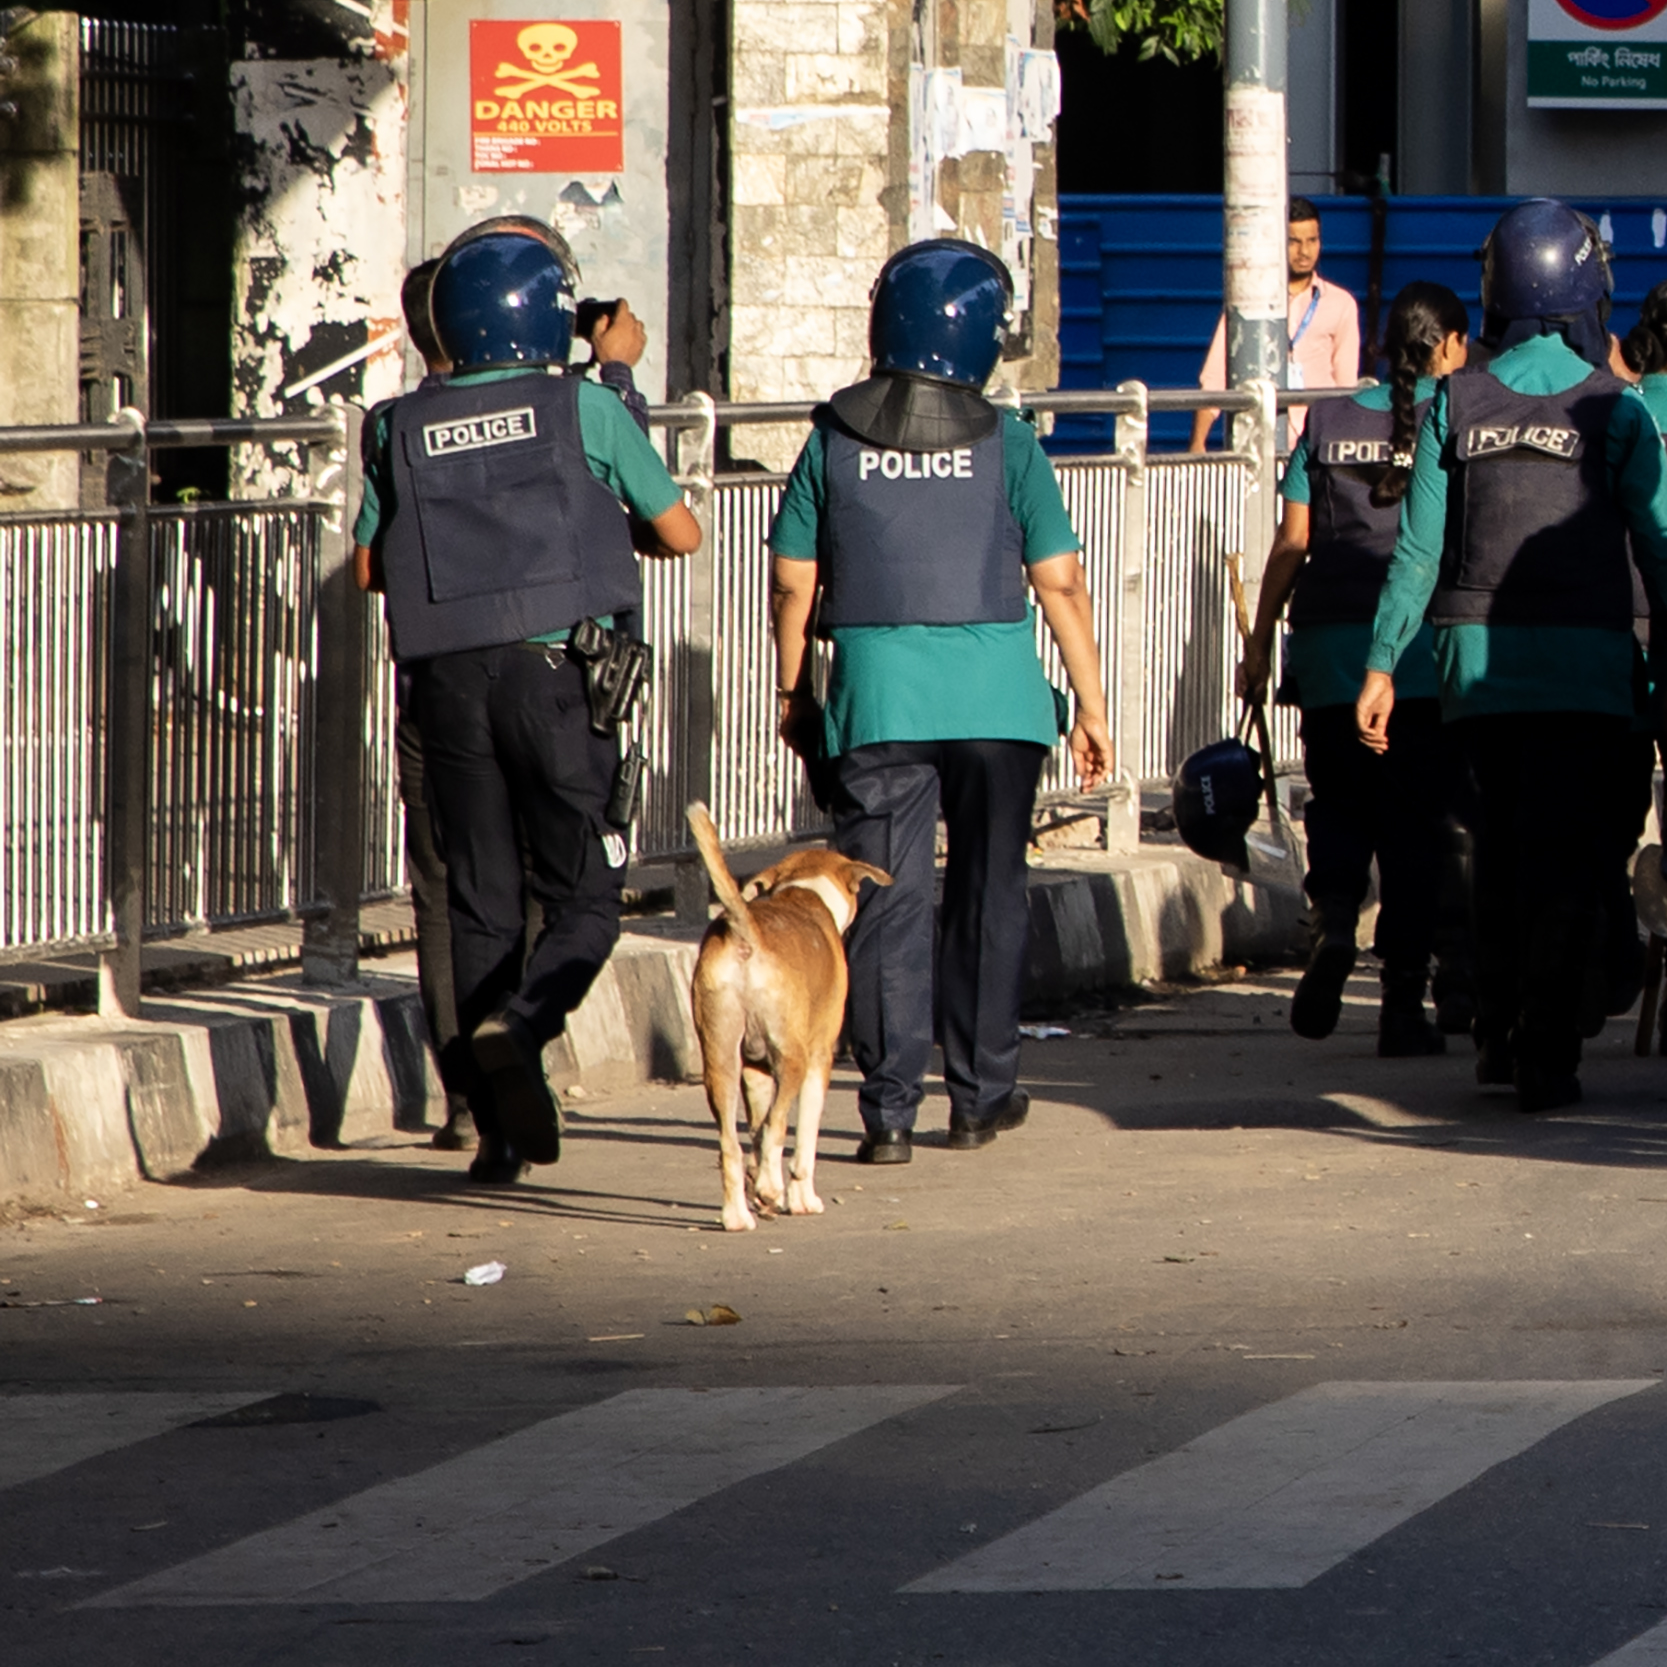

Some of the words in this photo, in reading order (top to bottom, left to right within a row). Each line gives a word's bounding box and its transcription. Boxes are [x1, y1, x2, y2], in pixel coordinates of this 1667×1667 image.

[1567, 46, 1611, 69] পার্কিং
[1614, 46, 1661, 68] নিষেধ
[1581, 76, 1598, 87] No
[1602, 76, 1647, 90] Parking
[475, 100, 618, 119] DANGER
[497, 120, 530, 132] 440
[535, 120, 592, 132] VOLTS
[434, 415, 525, 449] POLICE
[1477, 426, 1570, 452] POLICE
[859, 448, 973, 480] POLICE
